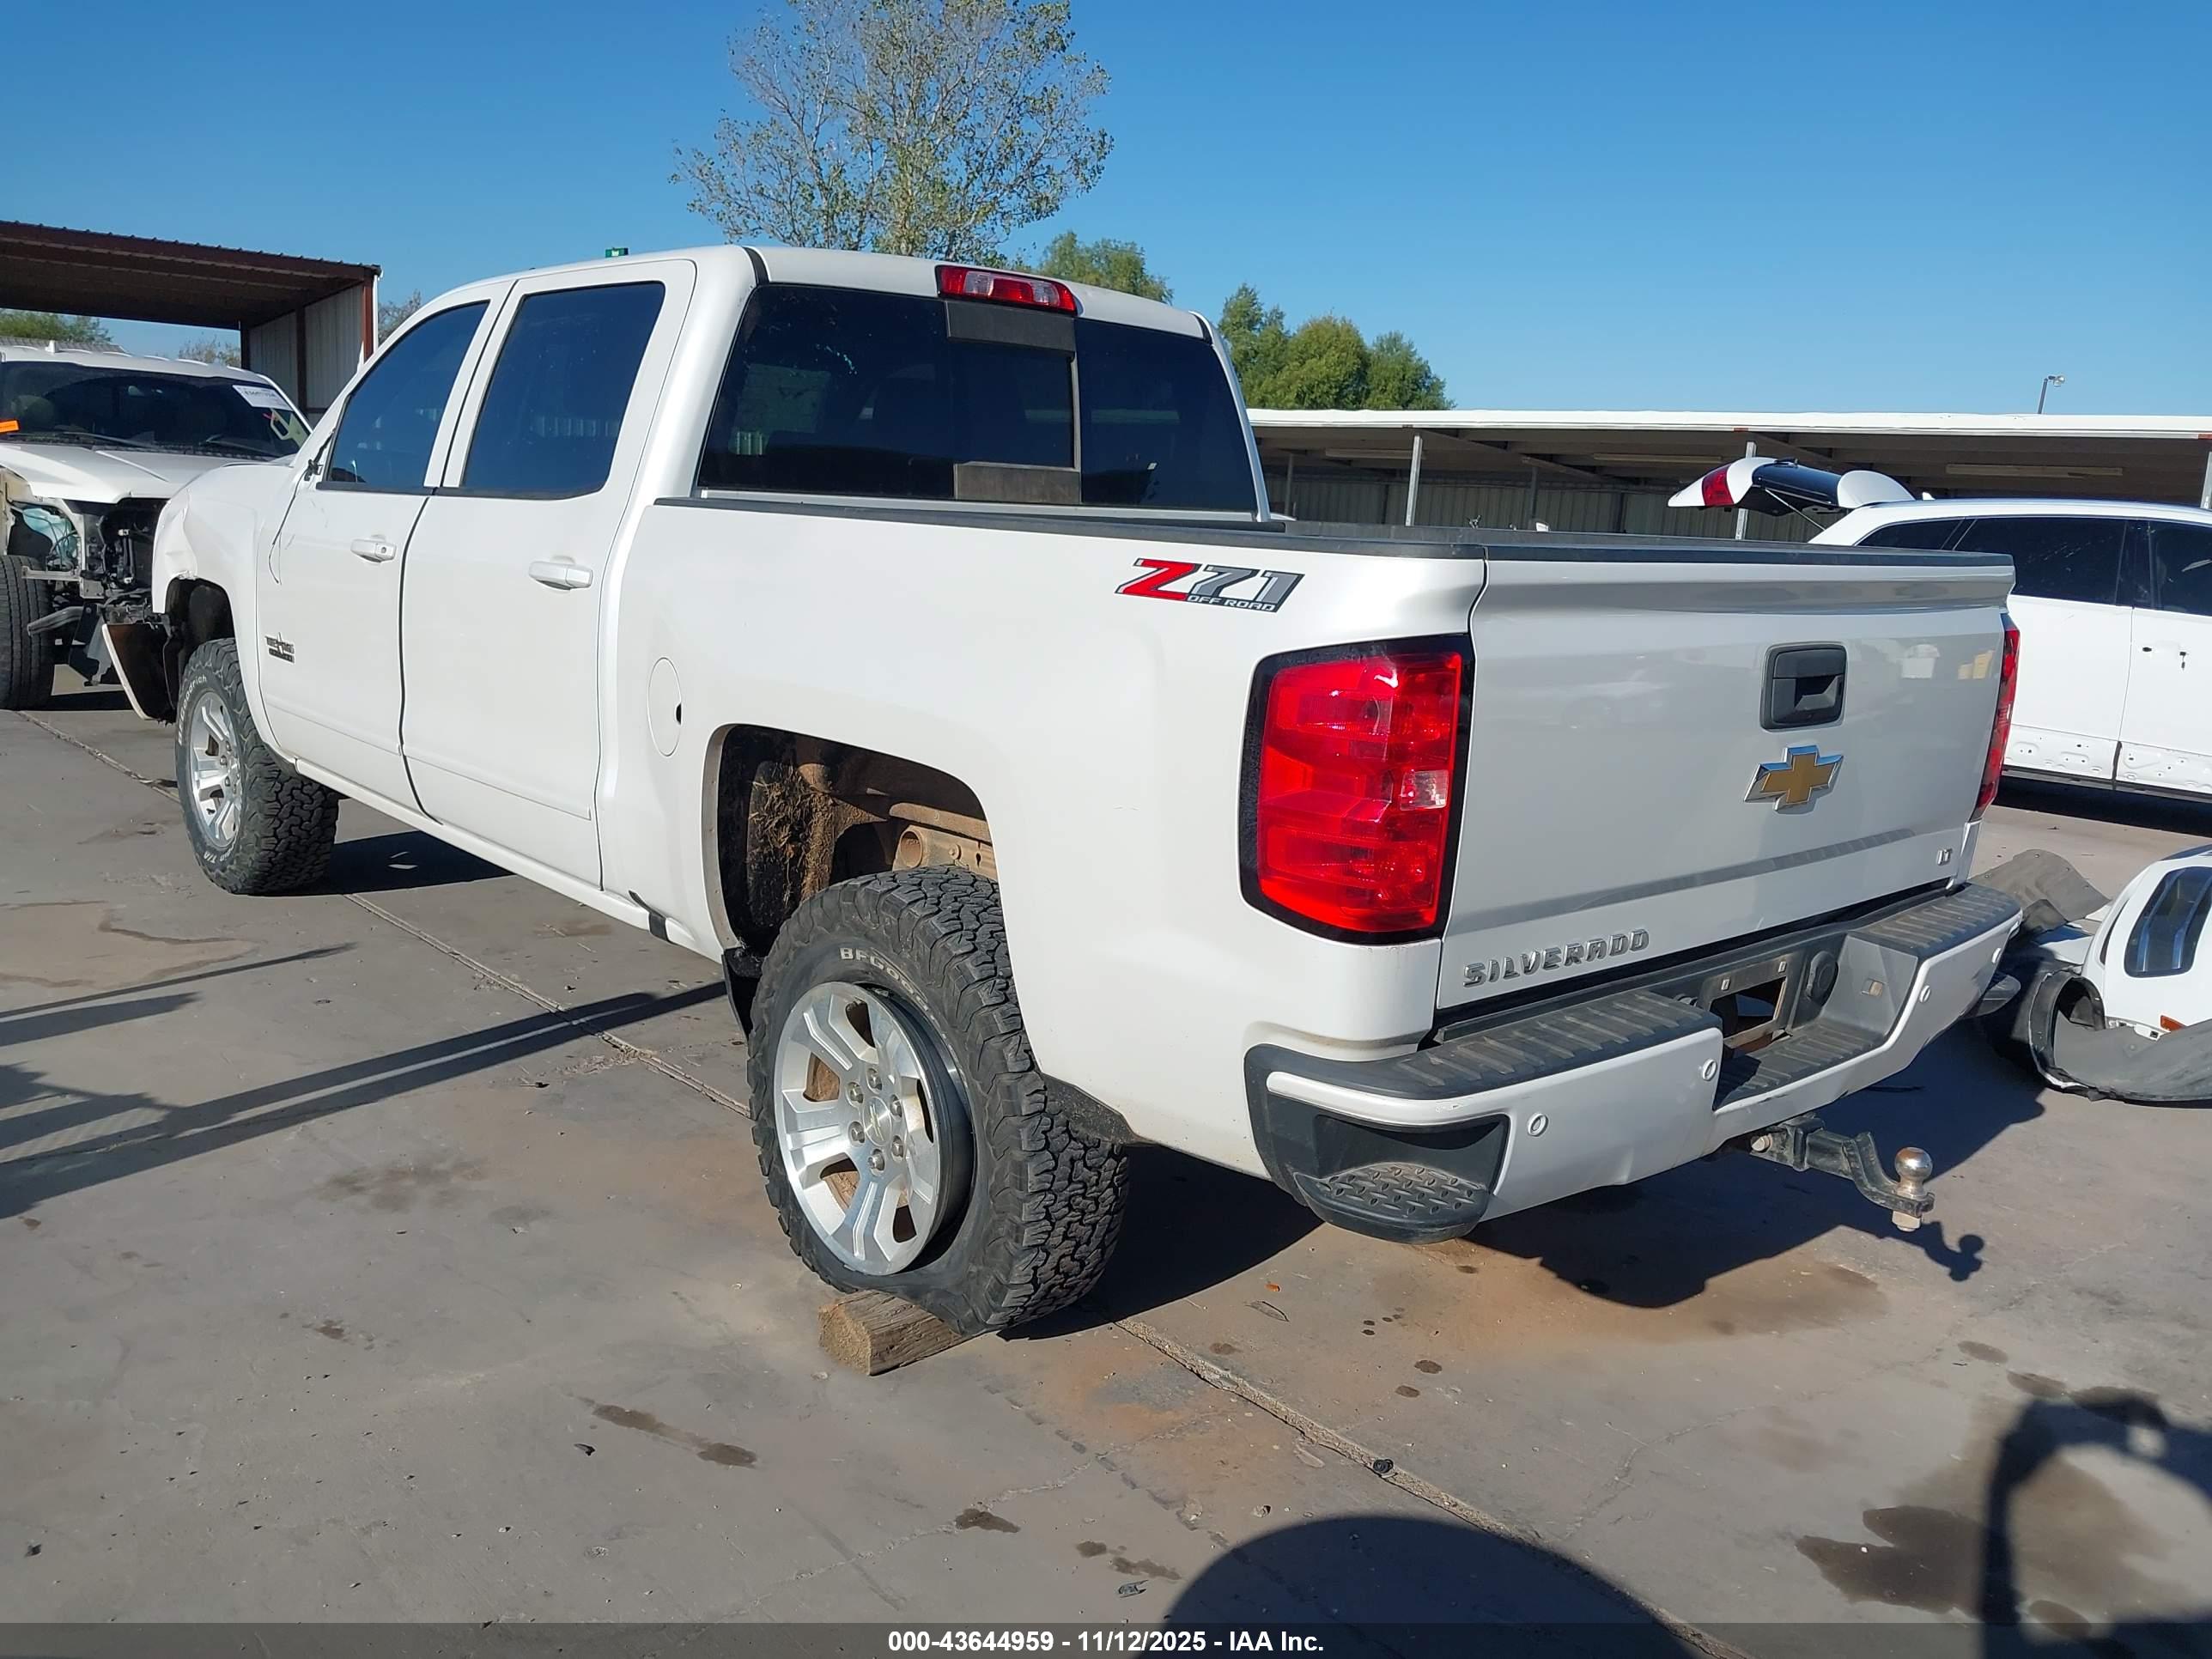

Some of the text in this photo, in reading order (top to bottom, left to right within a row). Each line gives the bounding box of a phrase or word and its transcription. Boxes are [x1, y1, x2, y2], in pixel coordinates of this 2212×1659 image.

[1115, 557, 1305, 603] Z71
[1188, 595, 1276, 612] OFF ROAD
[1937, 848, 1953, 866] LT
[1462, 928, 1650, 988] SILVERADO
